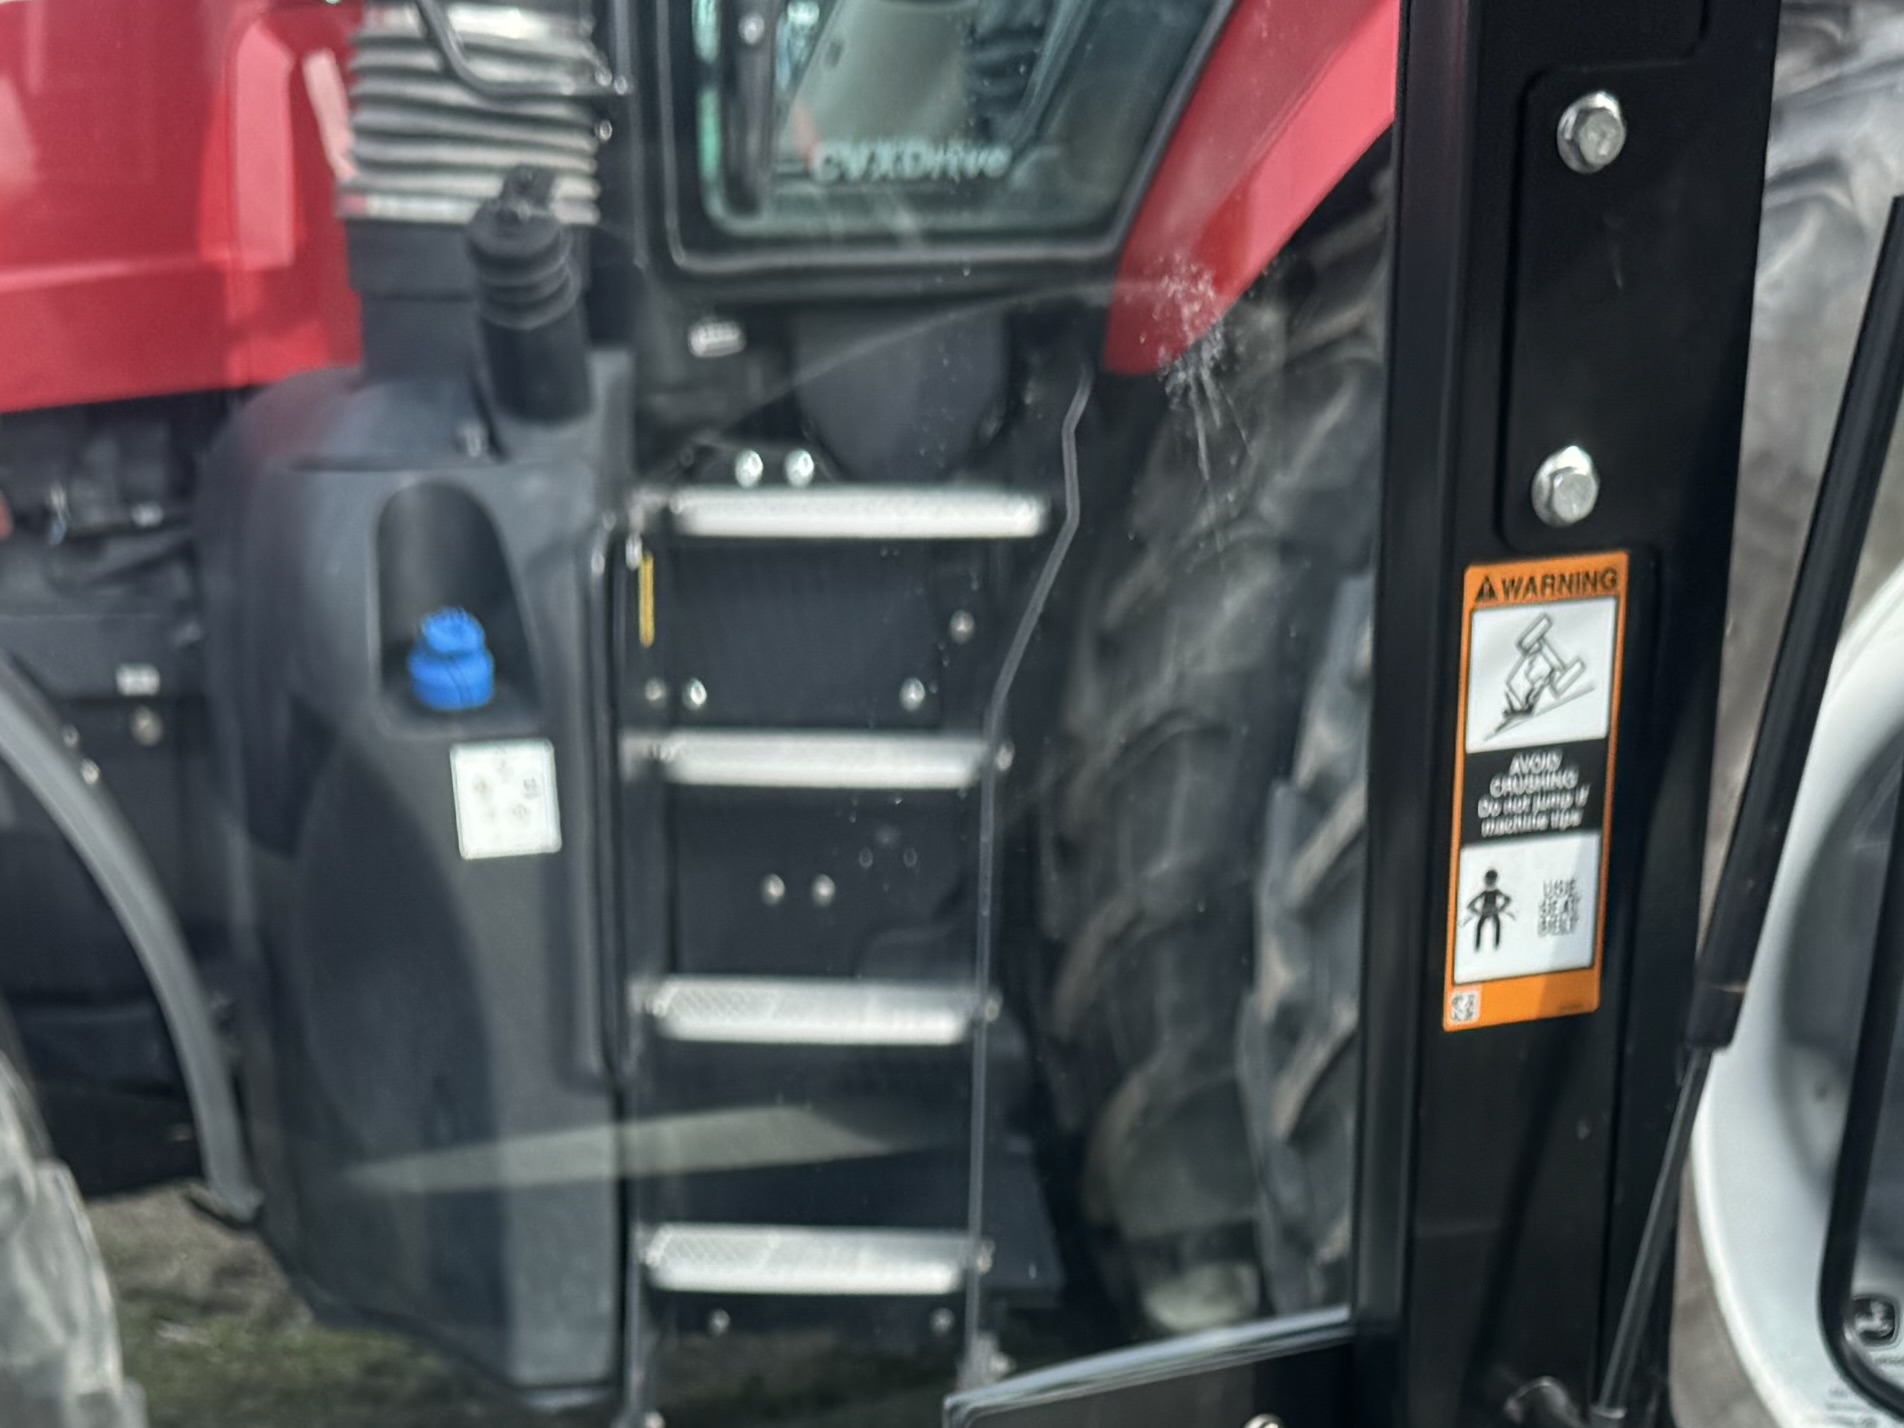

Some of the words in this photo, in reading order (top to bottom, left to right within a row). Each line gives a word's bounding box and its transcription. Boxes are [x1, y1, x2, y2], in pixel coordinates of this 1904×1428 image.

[1500, 568, 1618, 600] WARNING
[1508, 749, 1563, 775] AVOID
[1489, 766, 1579, 798] CRUSHING
[1477, 795, 1502, 818] Do
[1503, 793, 1531, 815] not
[1532, 790, 1574, 816] jump
[1481, 812, 1549, 838] machine
[1543, 879, 1577, 898] USE
[1539, 896, 1581, 915] SEAT
[1537, 915, 1580, 939] BELT
